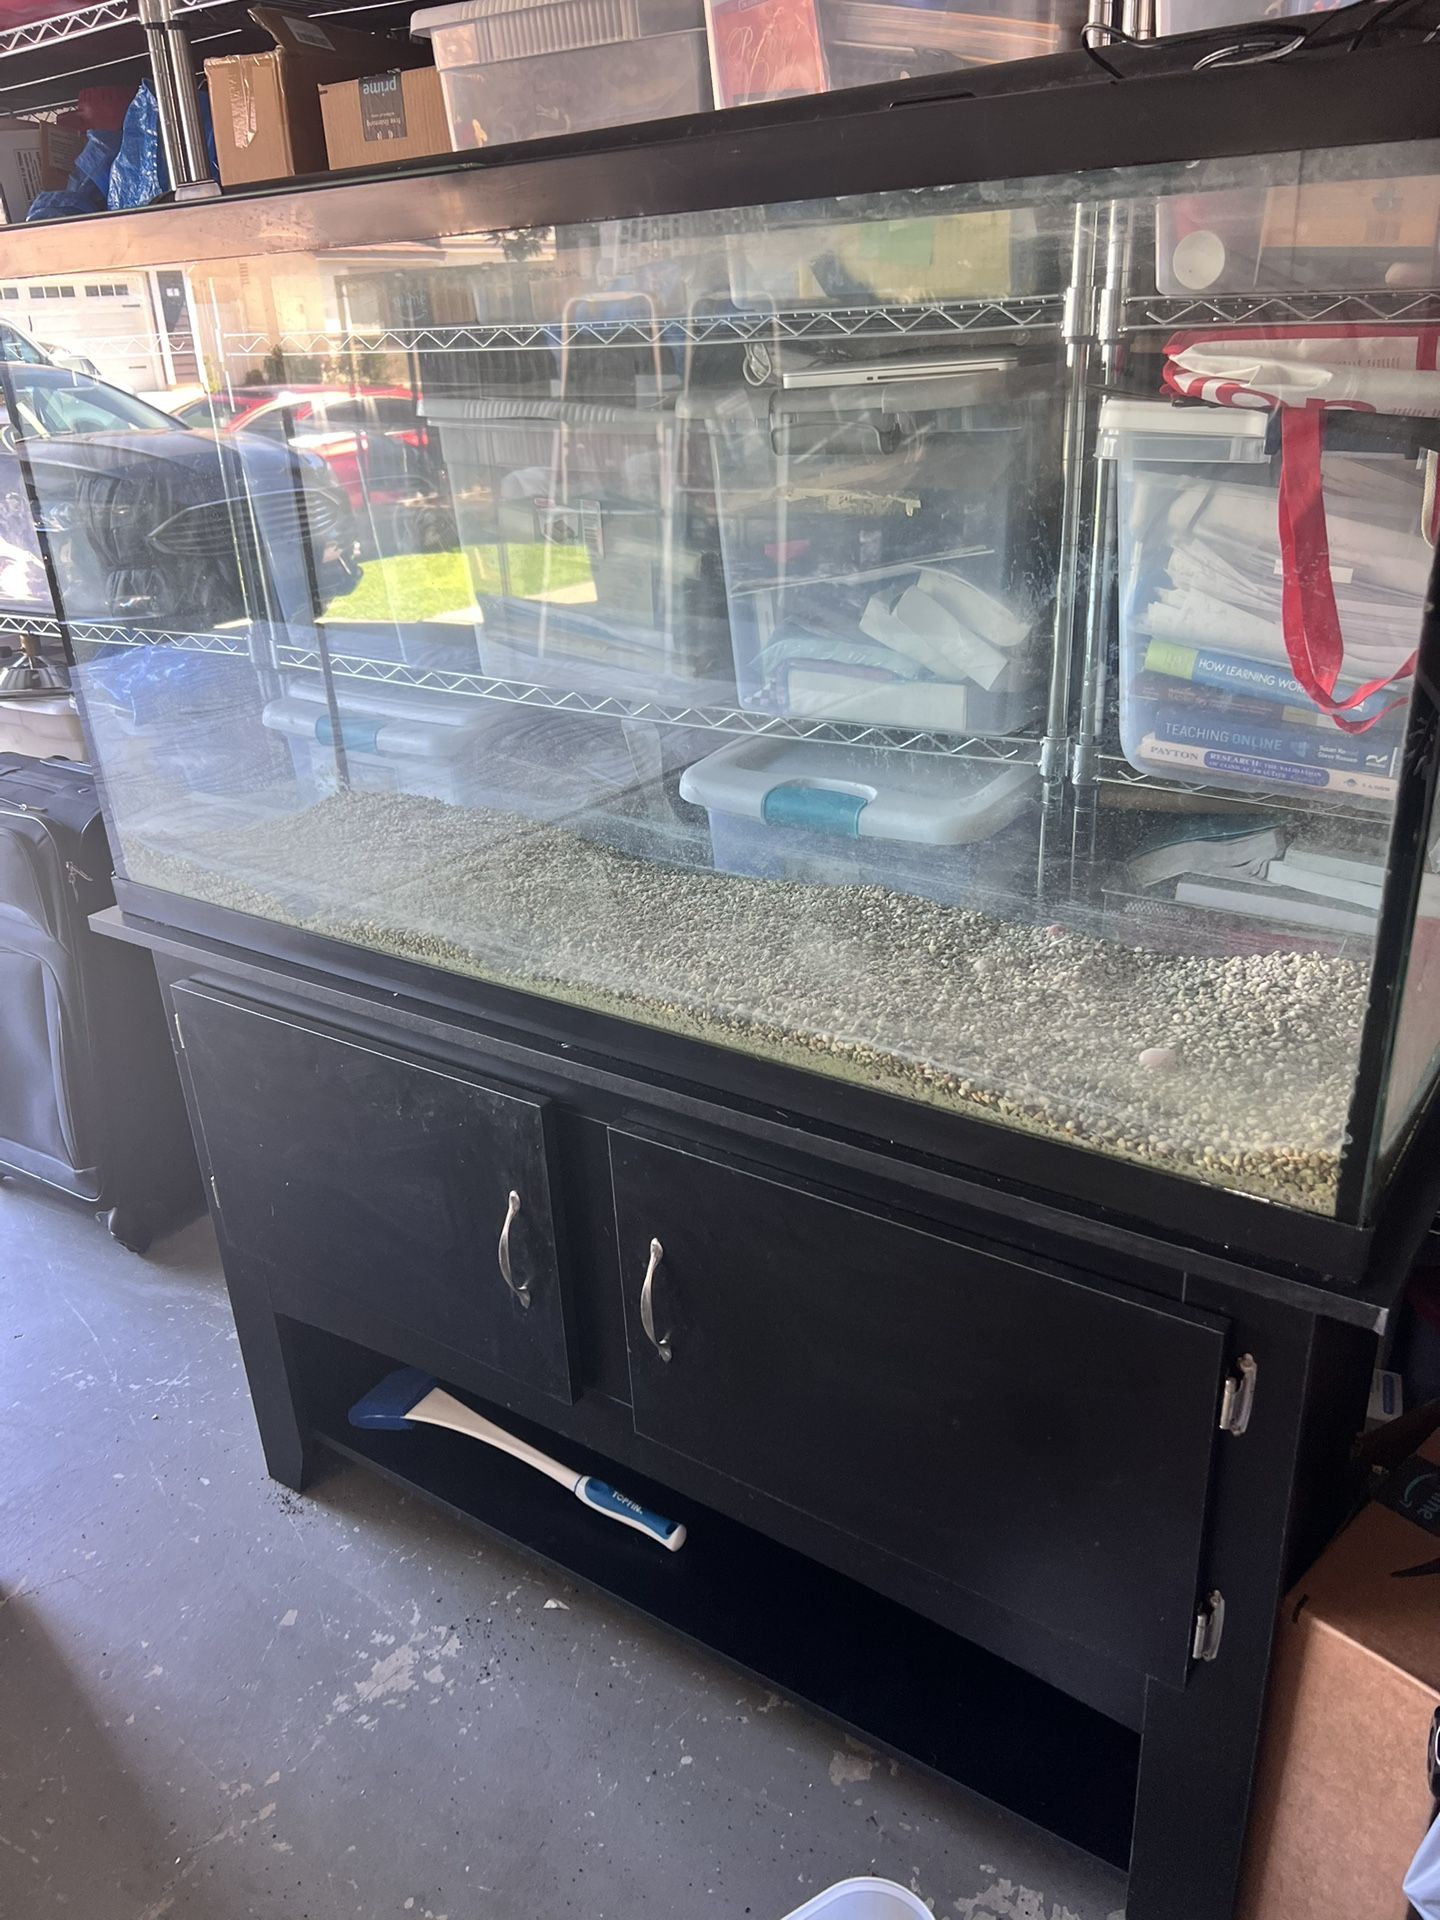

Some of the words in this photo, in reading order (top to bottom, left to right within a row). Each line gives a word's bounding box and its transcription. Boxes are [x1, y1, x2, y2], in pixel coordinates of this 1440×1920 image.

[363, 76, 397, 96] prime
[1198, 659, 1225, 672] HOW
[1226, 665, 1276, 686] LEARNING
[1278, 678, 1306, 693] WOR
[1165, 722, 1229, 743] TEACHING
[1232, 733, 1282, 751] ONLINE
[1150, 746, 1200, 760] PAYTON
